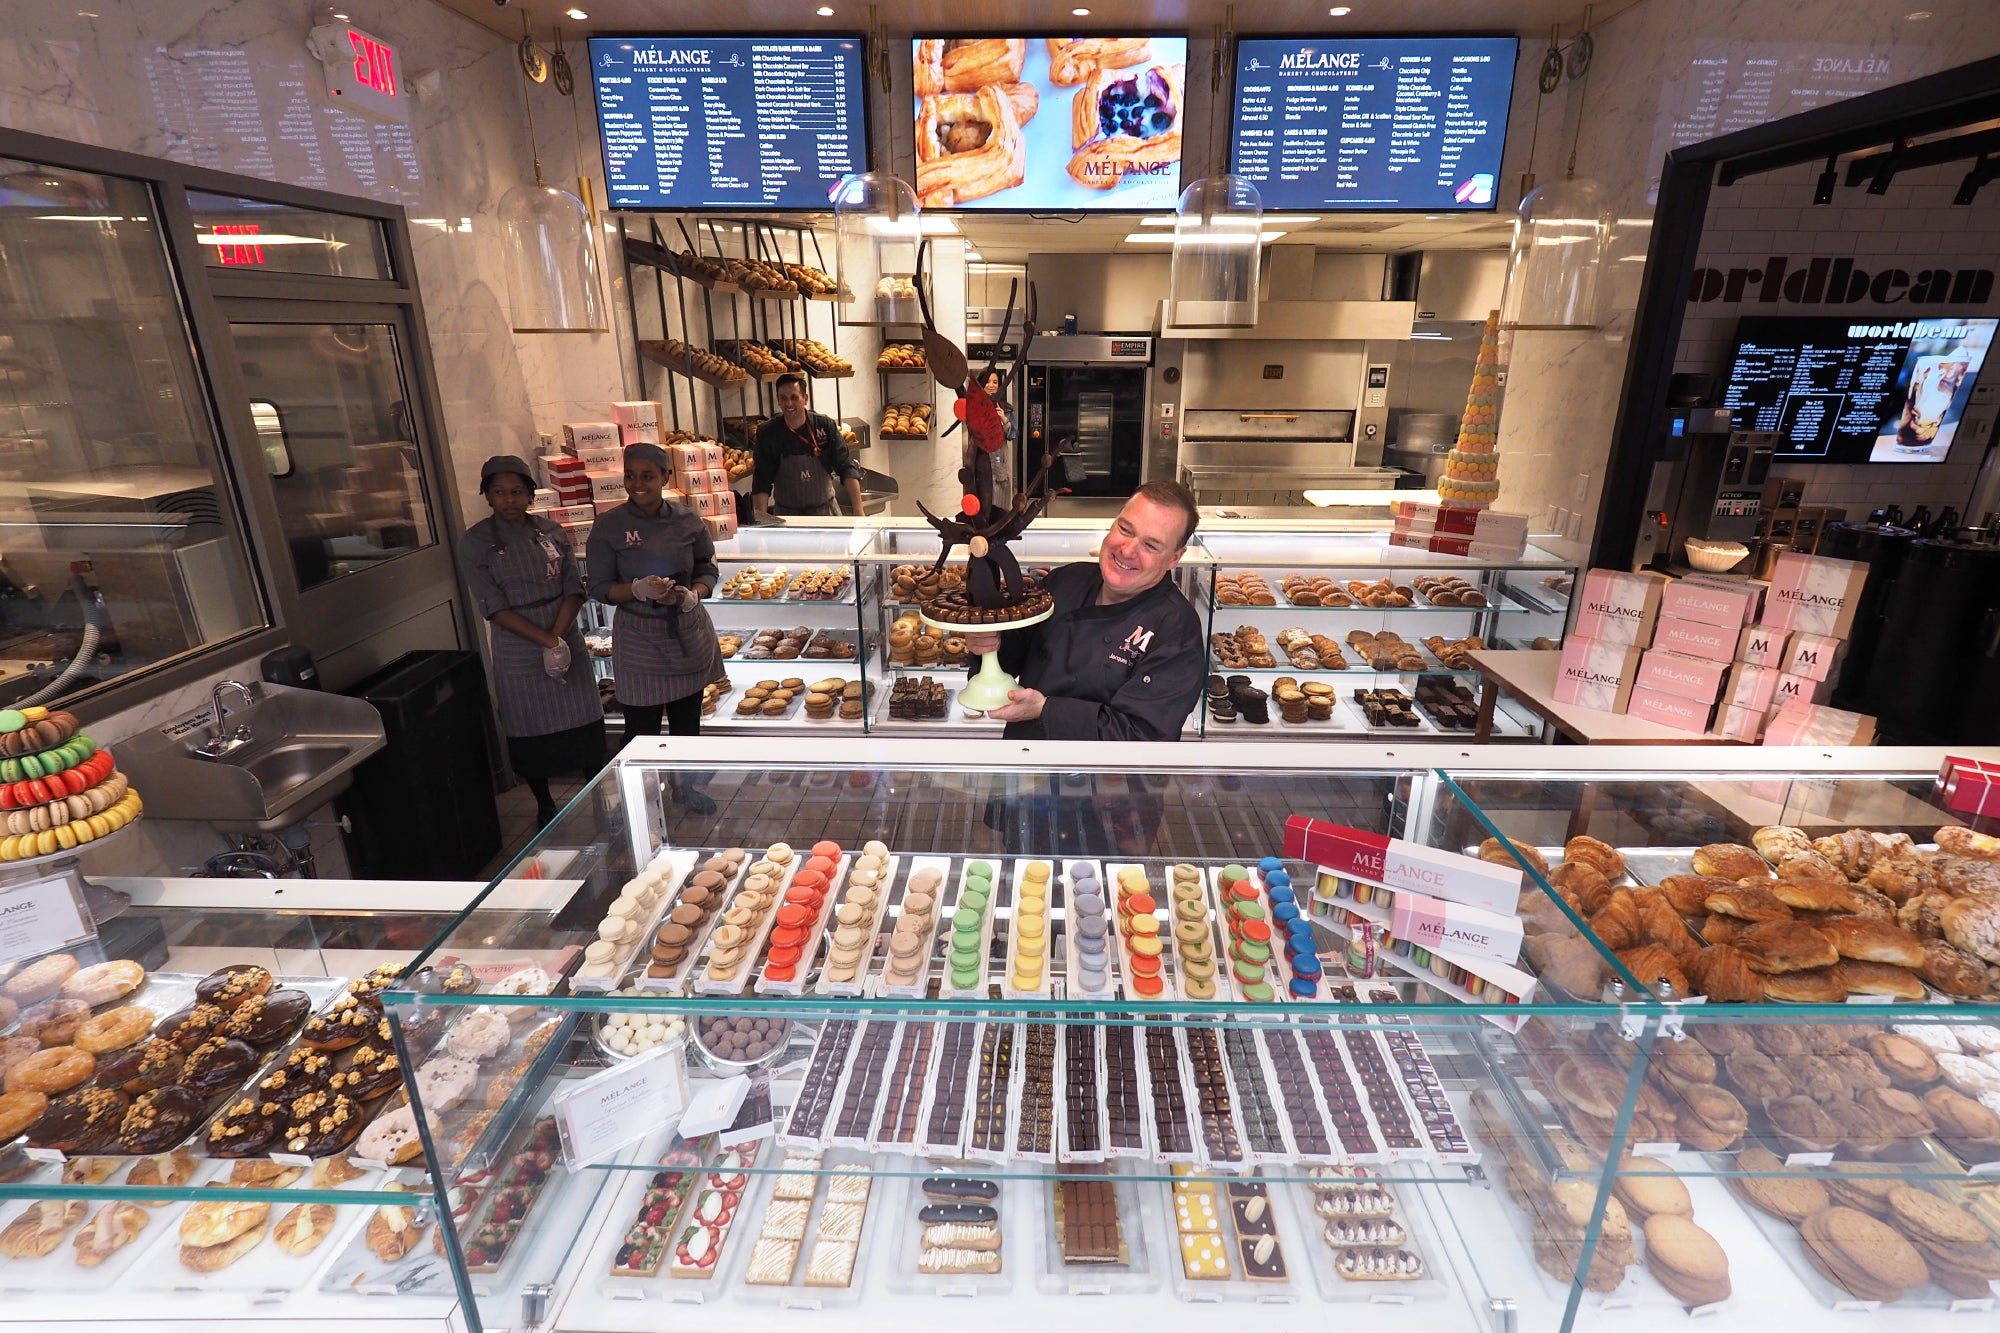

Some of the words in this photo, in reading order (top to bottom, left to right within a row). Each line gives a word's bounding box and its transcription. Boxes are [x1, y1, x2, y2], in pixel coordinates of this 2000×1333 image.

[633, 44, 711, 64] MÉLANGE
[1280, 48, 1360, 68] MÉLANGE
[348, 30, 396, 97] EXIT
[1084, 155, 1171, 175] MÉLANGE
[212, 225, 265, 264] EXIT
[1687, 257, 1994, 304] orldbean
[1848, 322, 1968, 338] worldbean
[688, 454, 696, 462] M
[708, 452, 717, 460] M
[692, 477, 701, 485] M
[625, 531, 642, 542] M
[546, 561, 560, 576] M
[1676, 596, 1729, 613] MÉLANGE
[1778, 588, 1846, 607] MÉLANGE
[1588, 602, 1645, 618] MÉLANGE
[1124, 626, 1154, 652] M
[1668, 628, 1721, 646] MÉLANGE
[1750, 639, 1768, 652] M
[1798, 650, 1817, 664] M
[1566, 668, 1622, 685] MÉLANGE
[1651, 666, 1704, 685] MÉLANGE
[1781, 682, 1799, 696] M
[1643, 699, 1693, 717] MÉLANGE
[162, 718, 195, 735] Employees
[196, 711, 211, 720] Must
[174, 726, 191, 735] Wash
[191, 718, 210, 728] Hands
[1353, 852, 1445, 886] MÉLANGE
[1419, 922, 1489, 945] MÉLANGE
[601, 1077, 648, 1104] MÉLANGE
